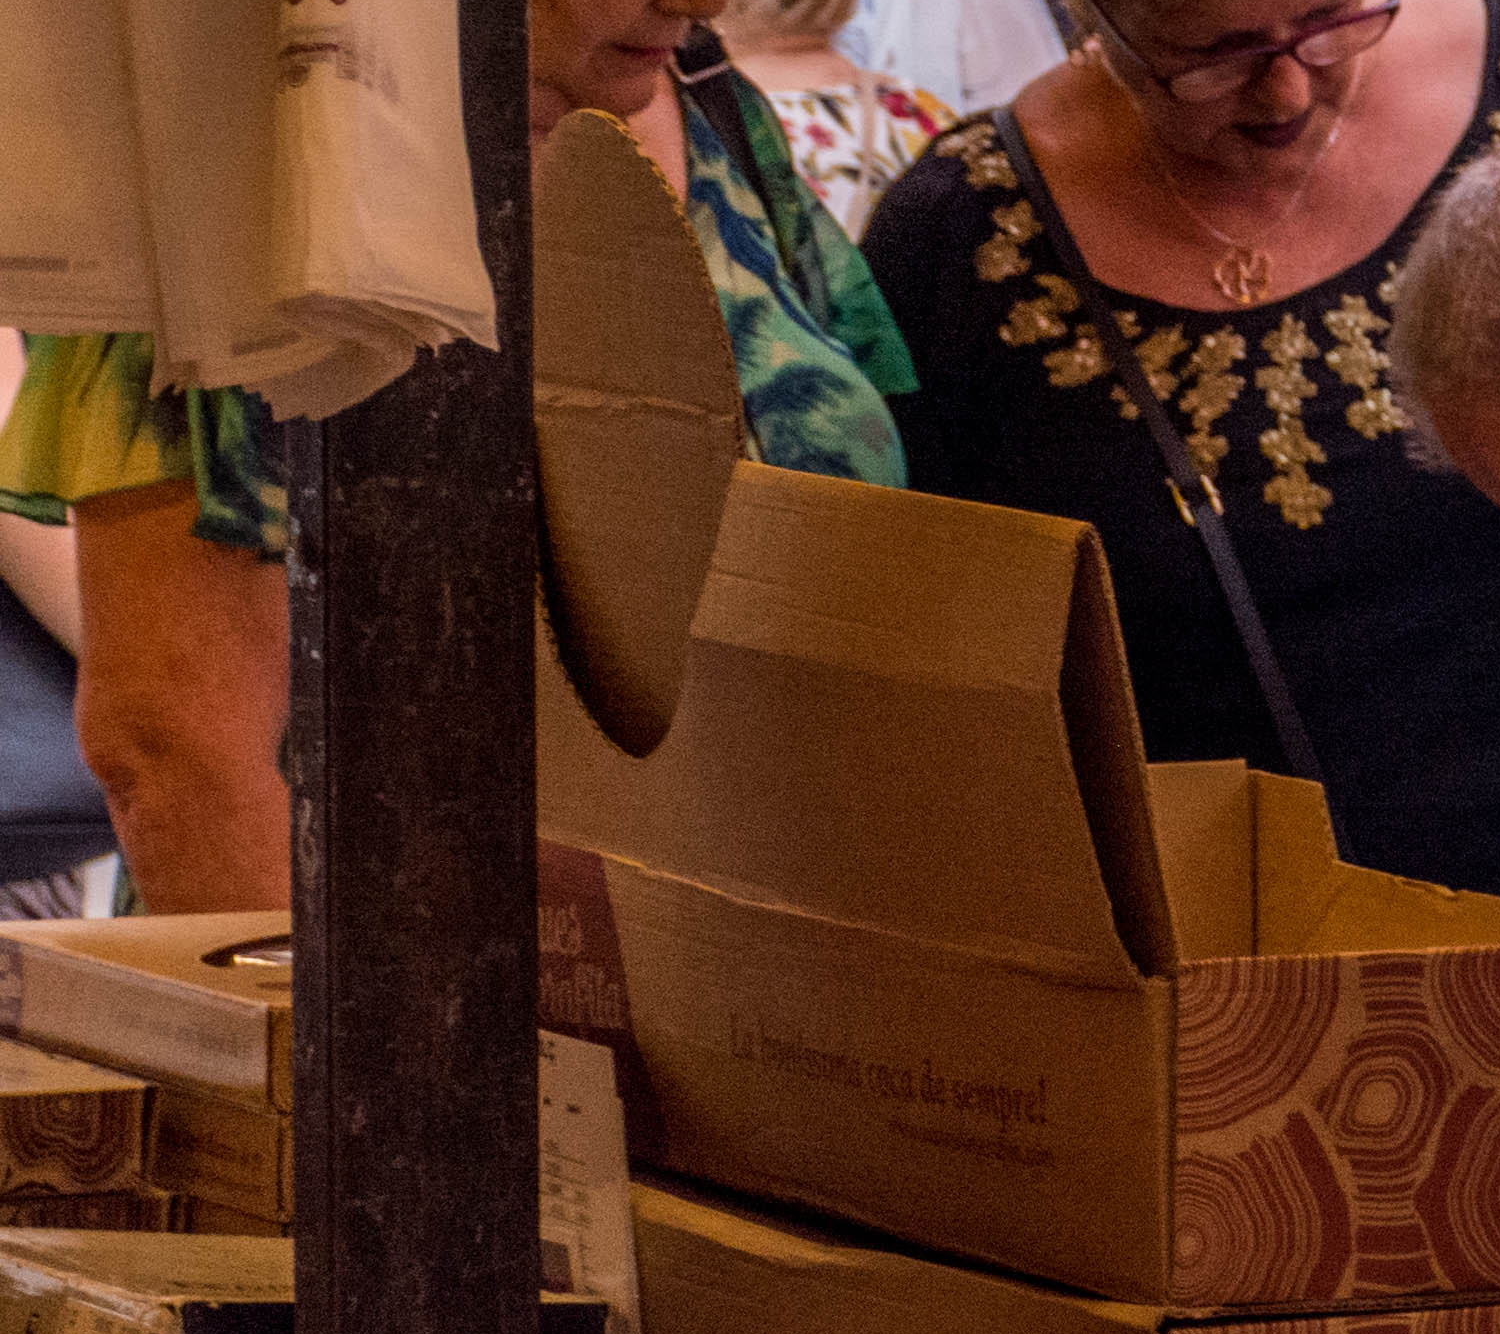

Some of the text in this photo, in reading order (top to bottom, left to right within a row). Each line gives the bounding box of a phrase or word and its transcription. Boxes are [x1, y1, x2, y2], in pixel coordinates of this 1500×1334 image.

[866, 1062, 916, 1102] coca
[920, 1056, 946, 1105] de
[950, 1075, 1047, 1134] sempre!
